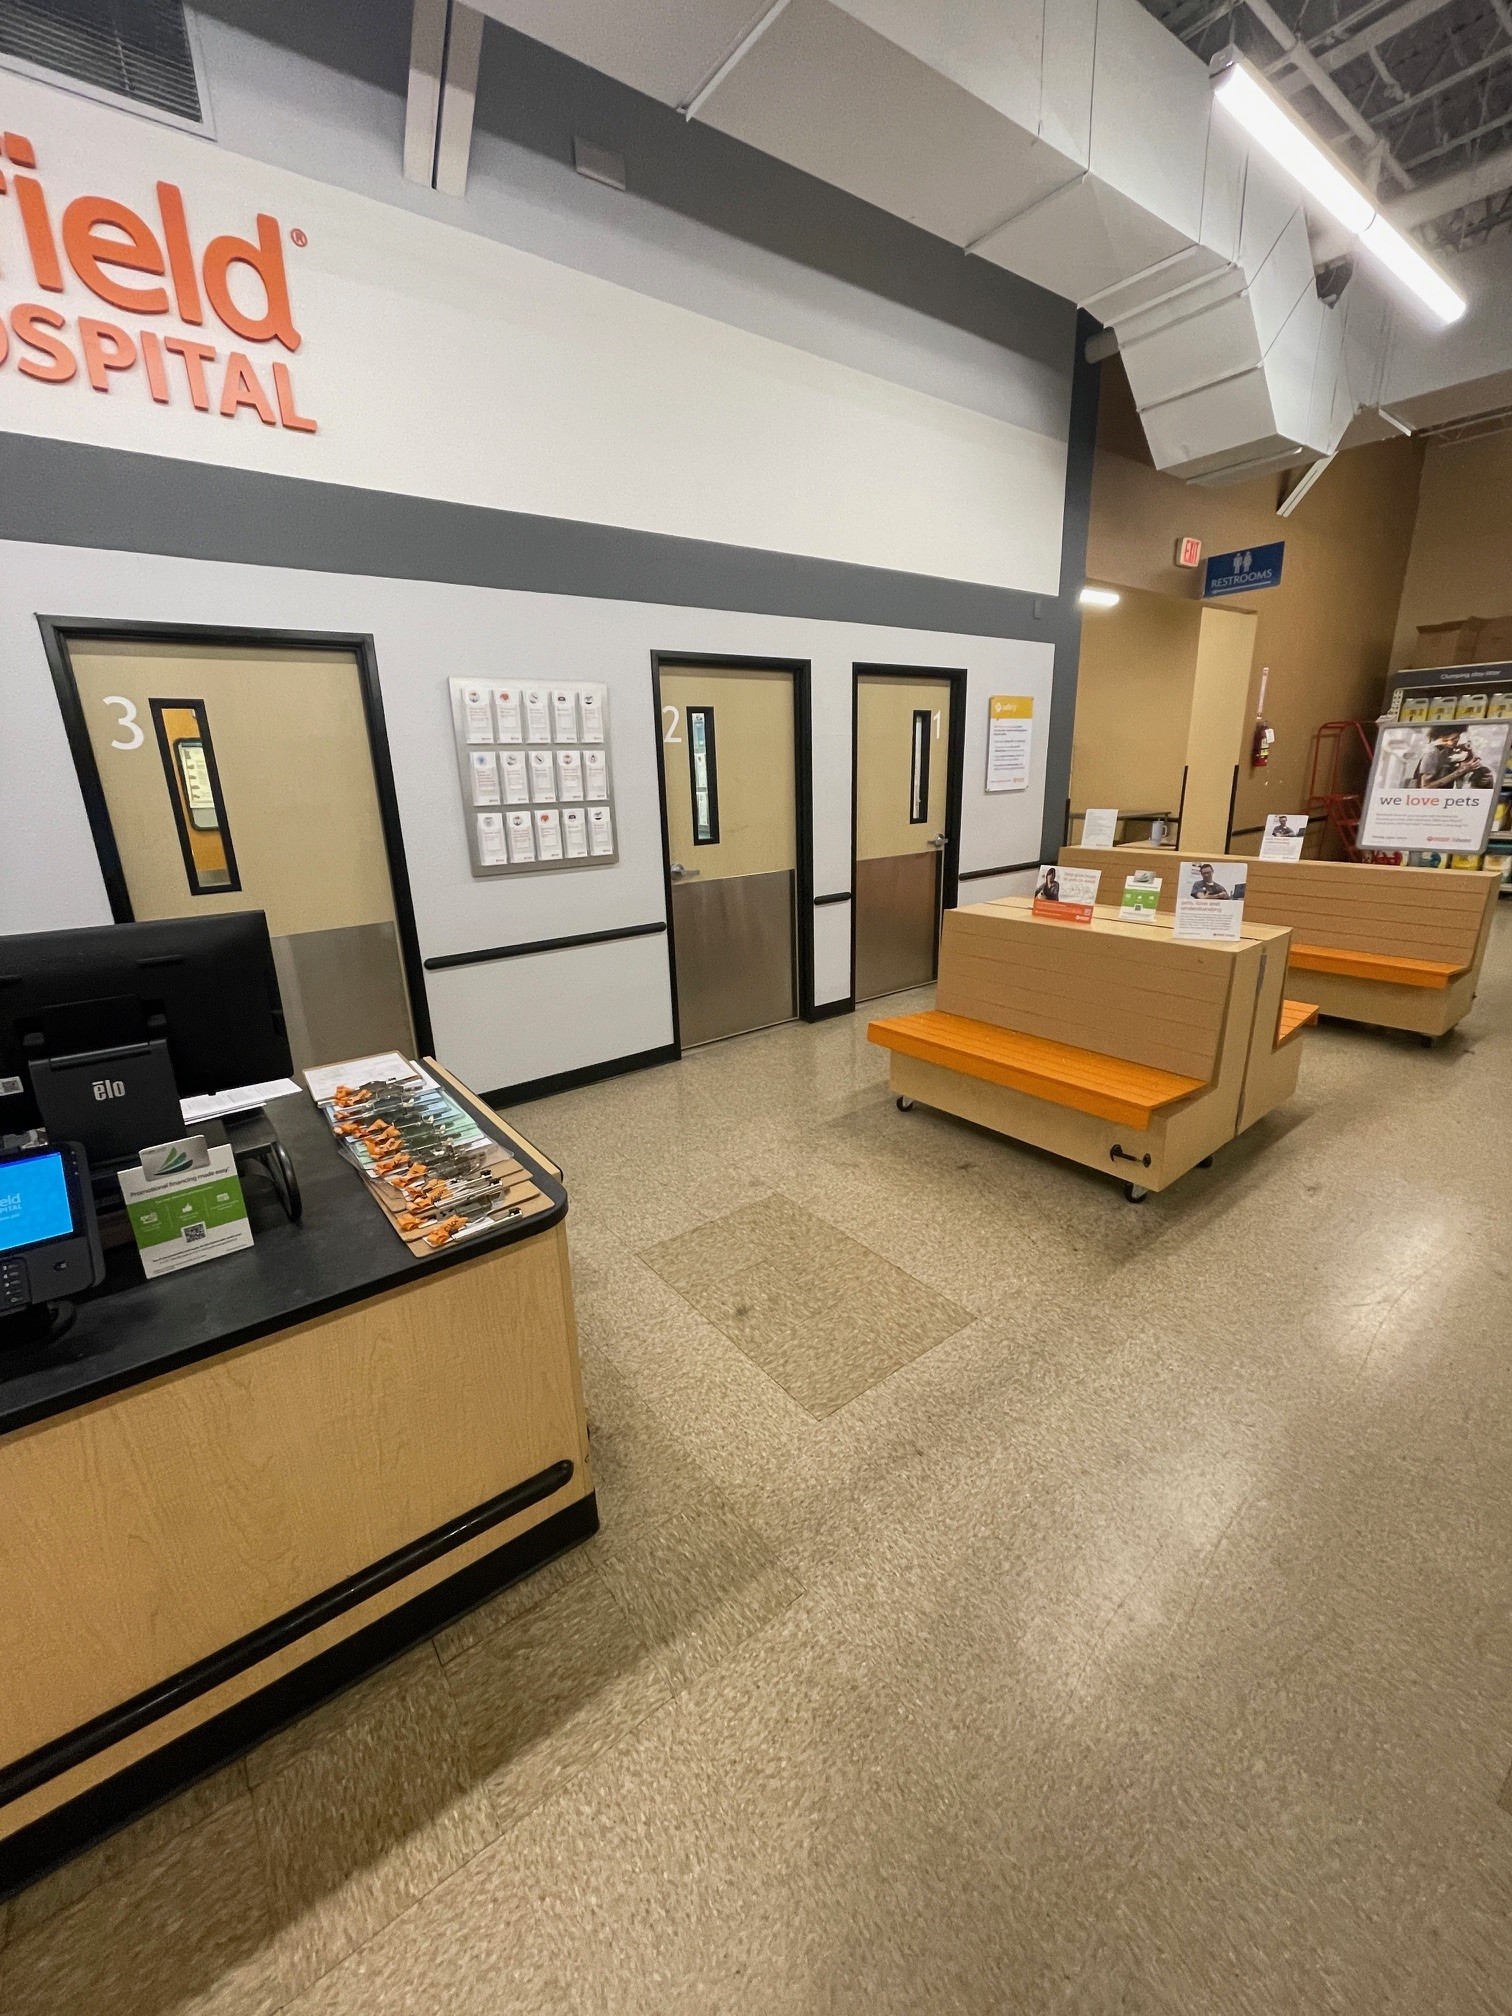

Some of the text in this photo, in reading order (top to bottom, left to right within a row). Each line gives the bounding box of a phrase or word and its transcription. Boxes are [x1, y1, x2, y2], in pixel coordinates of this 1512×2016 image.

[0, 303, 318, 433] SPITAL
[1211, 568, 1273, 588] RESTROOMS
[102, 695, 145, 751] 3
[661, 705, 682, 743] 2
[933, 710, 941, 739] 1
[1380, 794, 1480, 809] we love pets
[130, 1182, 169, 1198] Promotional
[169, 1175, 198, 1188] financing
[198, 1170, 215, 1180] made
[0, 1193, 21, 1207] eld
[0, 1203, 22, 1213] PITAL
